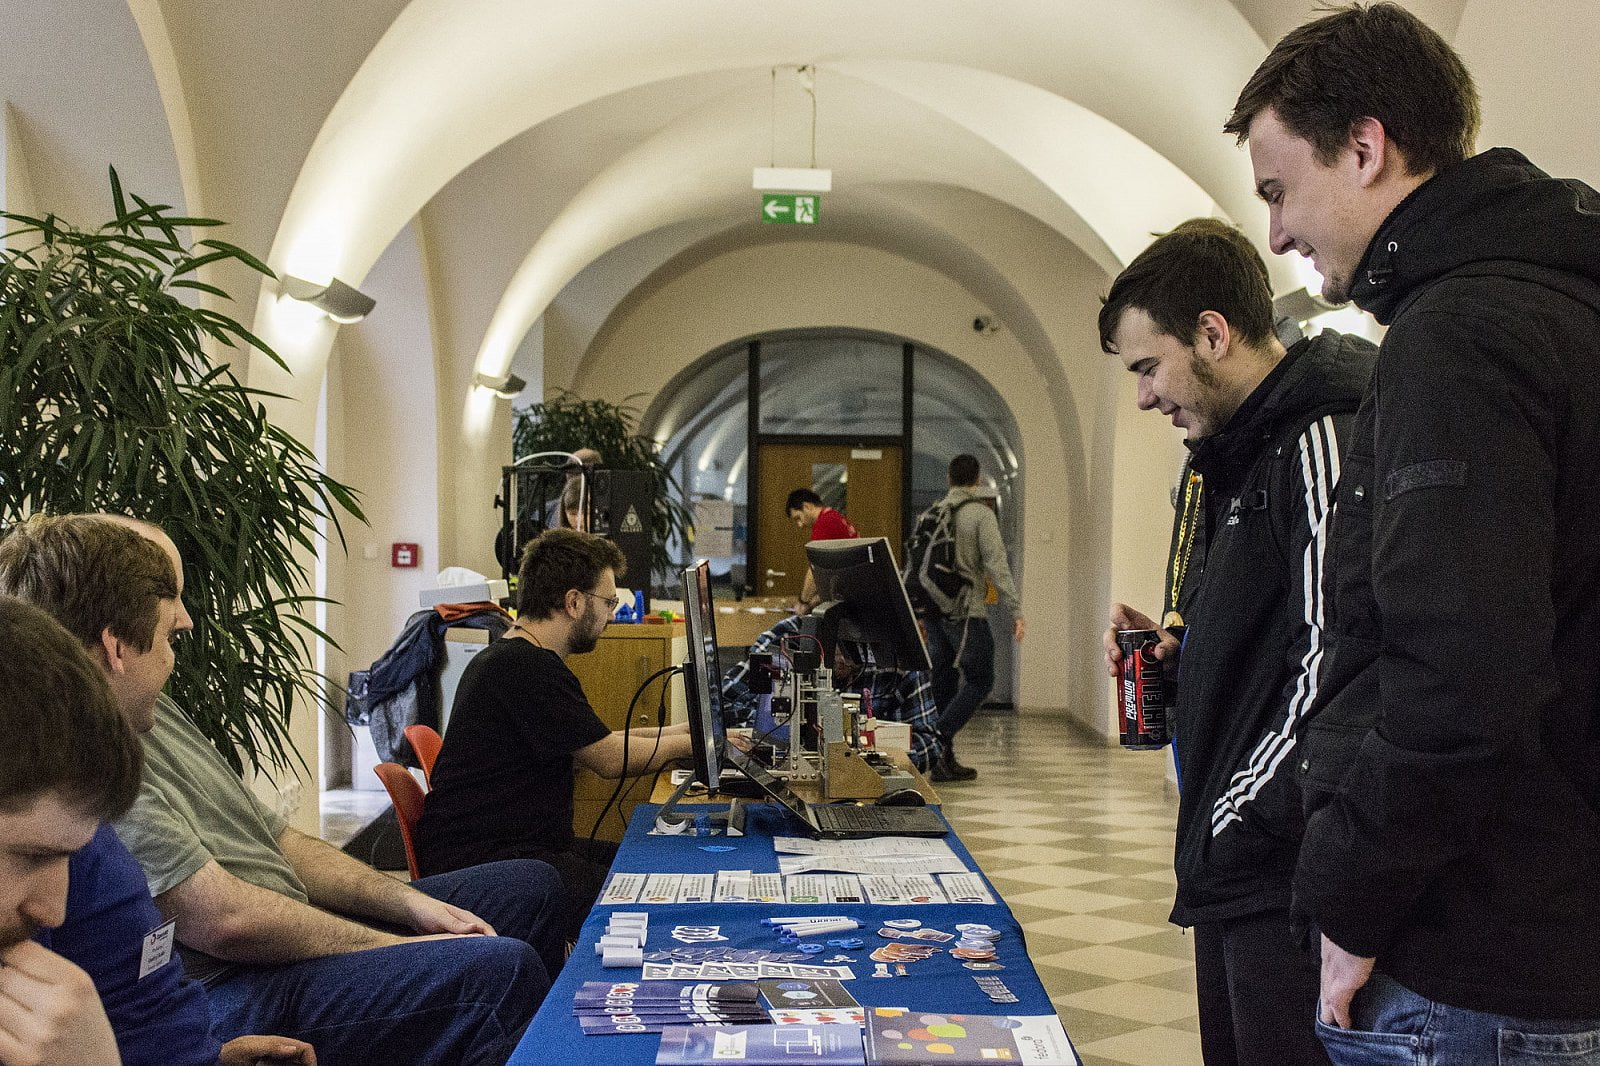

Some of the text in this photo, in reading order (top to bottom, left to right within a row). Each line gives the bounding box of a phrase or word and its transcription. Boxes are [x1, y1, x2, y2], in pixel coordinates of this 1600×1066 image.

[1124, 679, 1135, 720] PREMIUM
[1141, 670, 1163, 725] HELL
[1032, 1039, 1049, 1059] fedora
